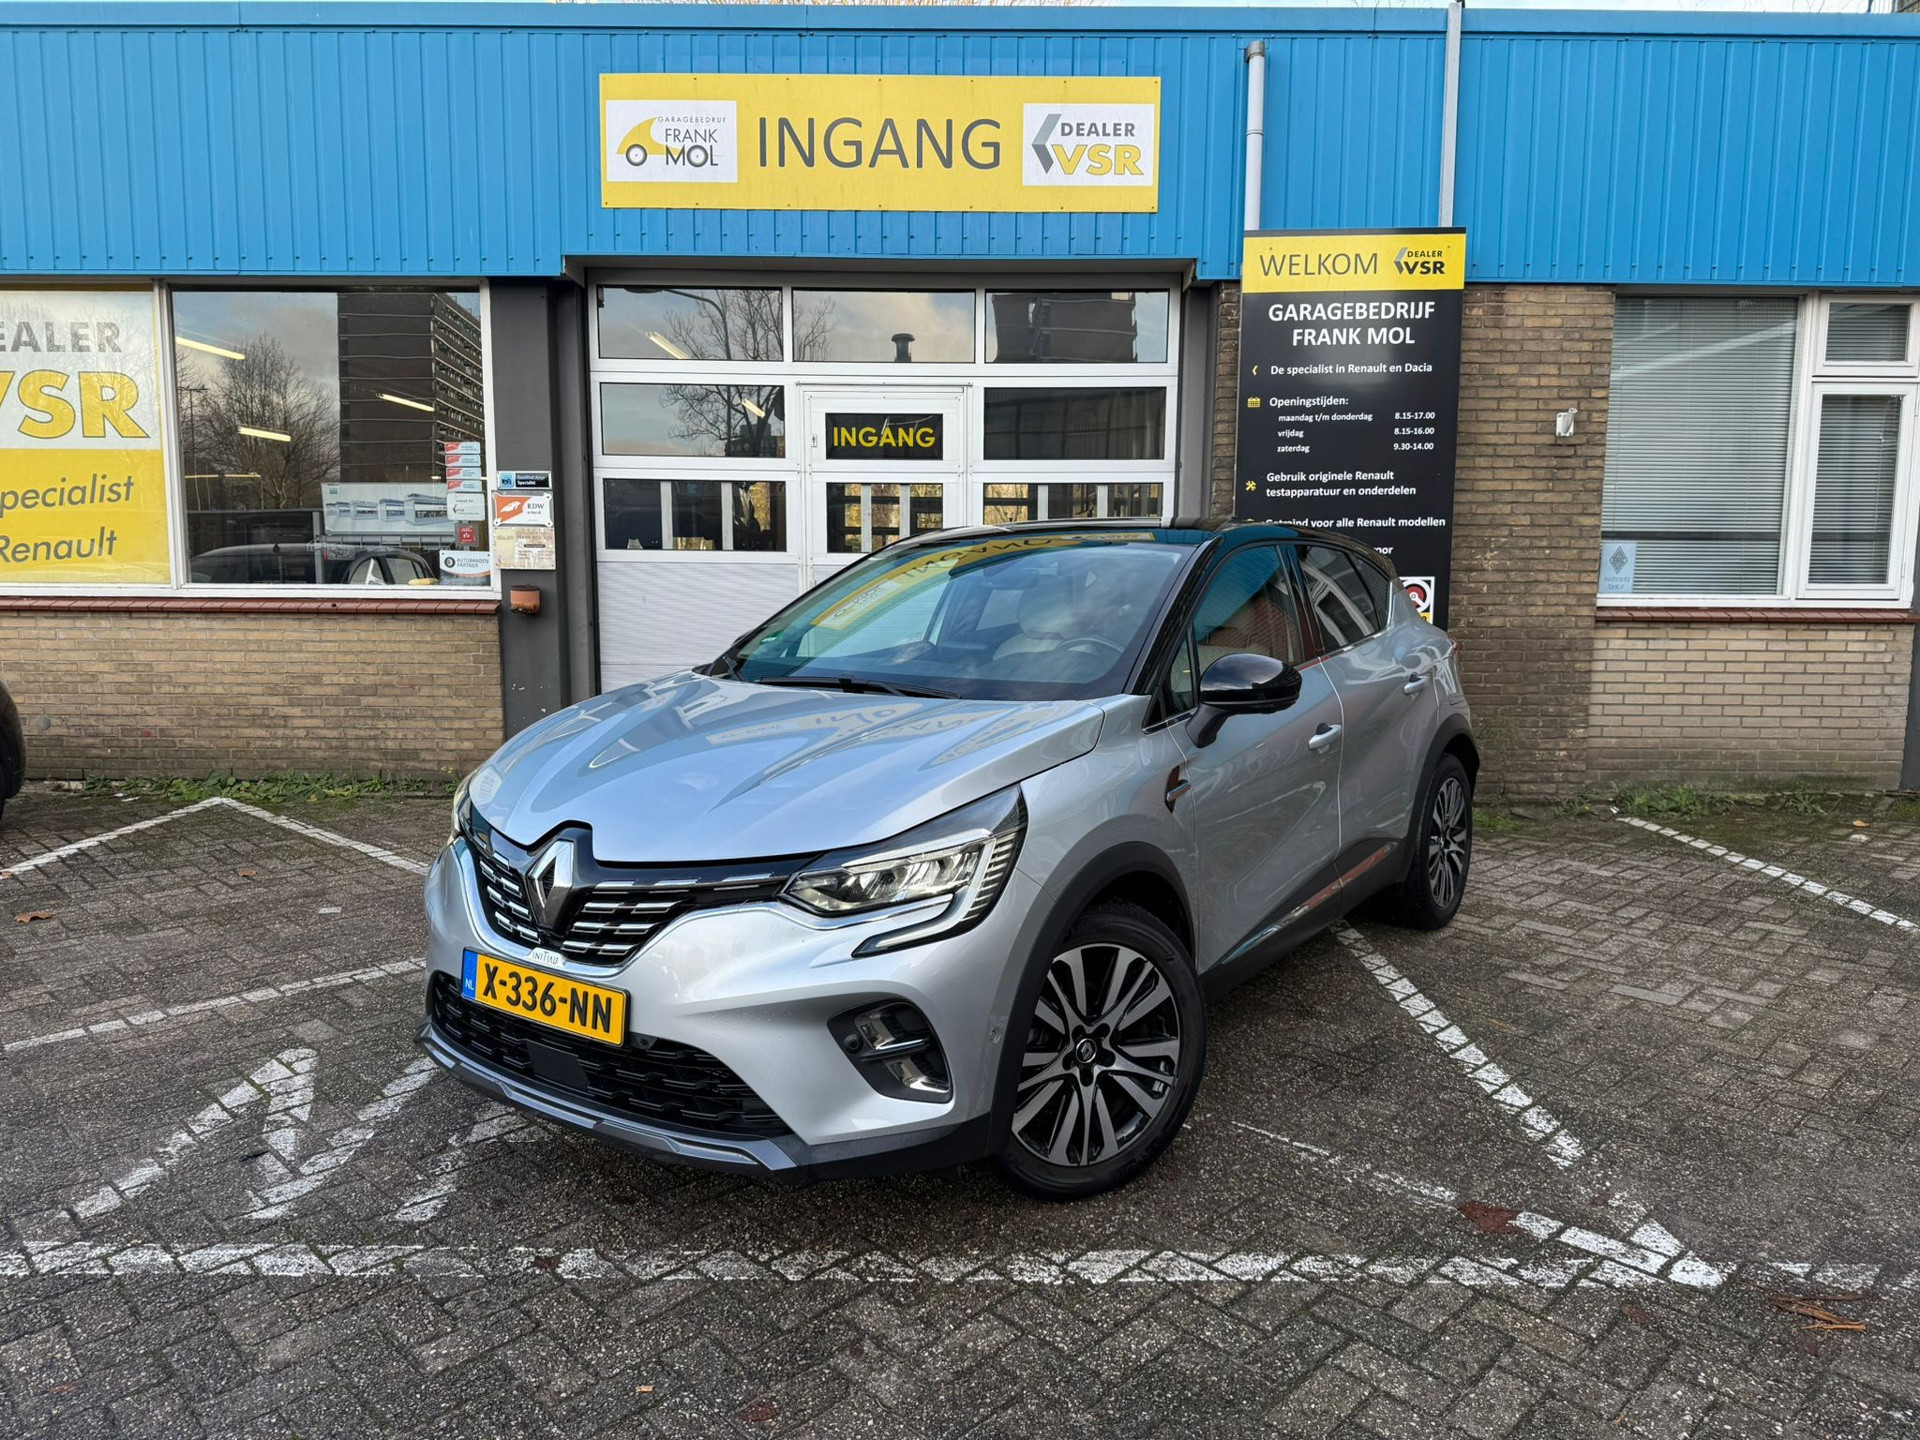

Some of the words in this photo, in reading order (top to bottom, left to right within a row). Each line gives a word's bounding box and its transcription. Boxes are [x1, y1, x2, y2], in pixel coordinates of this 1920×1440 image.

[665, 128, 718, 143] FRANK
[1060, 122, 1136, 137] DEALER
[759, 117, 1001, 170] INGANG
[665, 144, 719, 168] MOL
[1051, 143, 1145, 176] VSR
[1407, 250, 1443, 258] DEALER
[1259, 253, 1378, 276] WELKOM
[1403, 261, 1446, 275] VSR
[1268, 301, 1436, 322] GARAGEBEDRIJF
[1292, 328, 1363, 346] FRANK
[1367, 327, 1416, 345] MOL
[1270, 366, 1284, 375] De
[1286, 364, 1333, 376] specialist
[1336, 364, 1346, 374] in
[1348, 363, 1387, 373] Renault
[1389, 365, 1402, 373] en
[1405, 363, 1433, 372] Dacia
[0, 369, 150, 439] SR
[1269, 397, 1350, 408] Openingstijden:
[1278, 414, 1314, 423] maandag
[1315, 413, 1330, 422] t/m
[1331, 413, 1373, 422] donderdag
[1394, 412, 1436, 420] 8.15-17.00
[833, 427, 936, 448] INGANG
[1278, 430, 1304, 438] vrijdag
[1394, 427, 1435, 435] 8.15-16.00
[1277, 445, 1310, 453] zaterdag
[1266, 472, 1306, 482] Gebruik
[1308, 471, 1353, 483] originele
[1355, 470, 1395, 480] Renault
[1266, 488, 1342, 498] testapparatuur
[1343, 488, 1356, 496] en
[1358, 486, 1416, 496] onderdelen
[1336, 518, 1354, 527] alle
[1357, 517, 1396, 527] Renault
[1398, 517, 1446, 527] modellen
[1374, 546, 1394, 554] oor
[465, 978, 475, 991] NL
[483, 963, 612, 1034] X-336-NN
